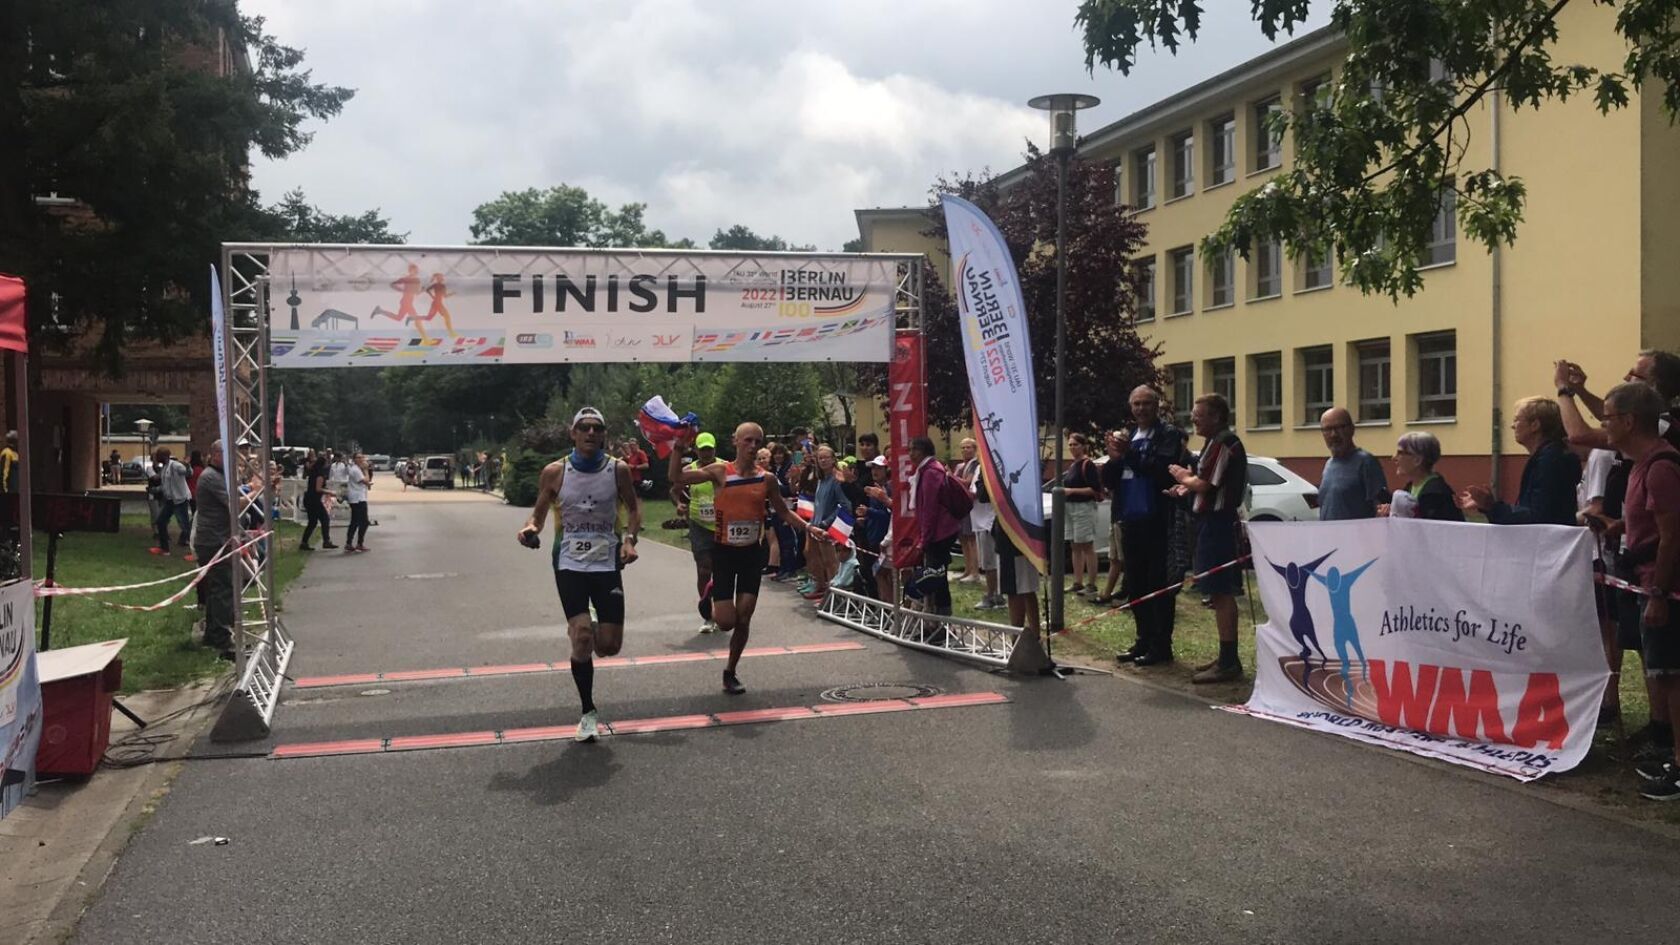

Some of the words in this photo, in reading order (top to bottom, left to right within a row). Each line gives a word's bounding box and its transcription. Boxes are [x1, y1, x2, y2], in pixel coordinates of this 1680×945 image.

[780, 270, 845, 285] BERLIN
[492, 274, 707, 314] FINISH
[742, 288, 777, 300] 2022
[780, 286, 853, 301] BERNAU
[893, 383, 915, 517] ZIEL
[700, 508, 714, 516] 155
[730, 527, 749, 536] 192
[575, 541, 592, 551] 29
[1379, 605, 1449, 636] Athletics
[1452, 610, 1481, 641] for
[1486, 618, 1528, 654] Life
[1366, 659, 1569, 750] WMA
